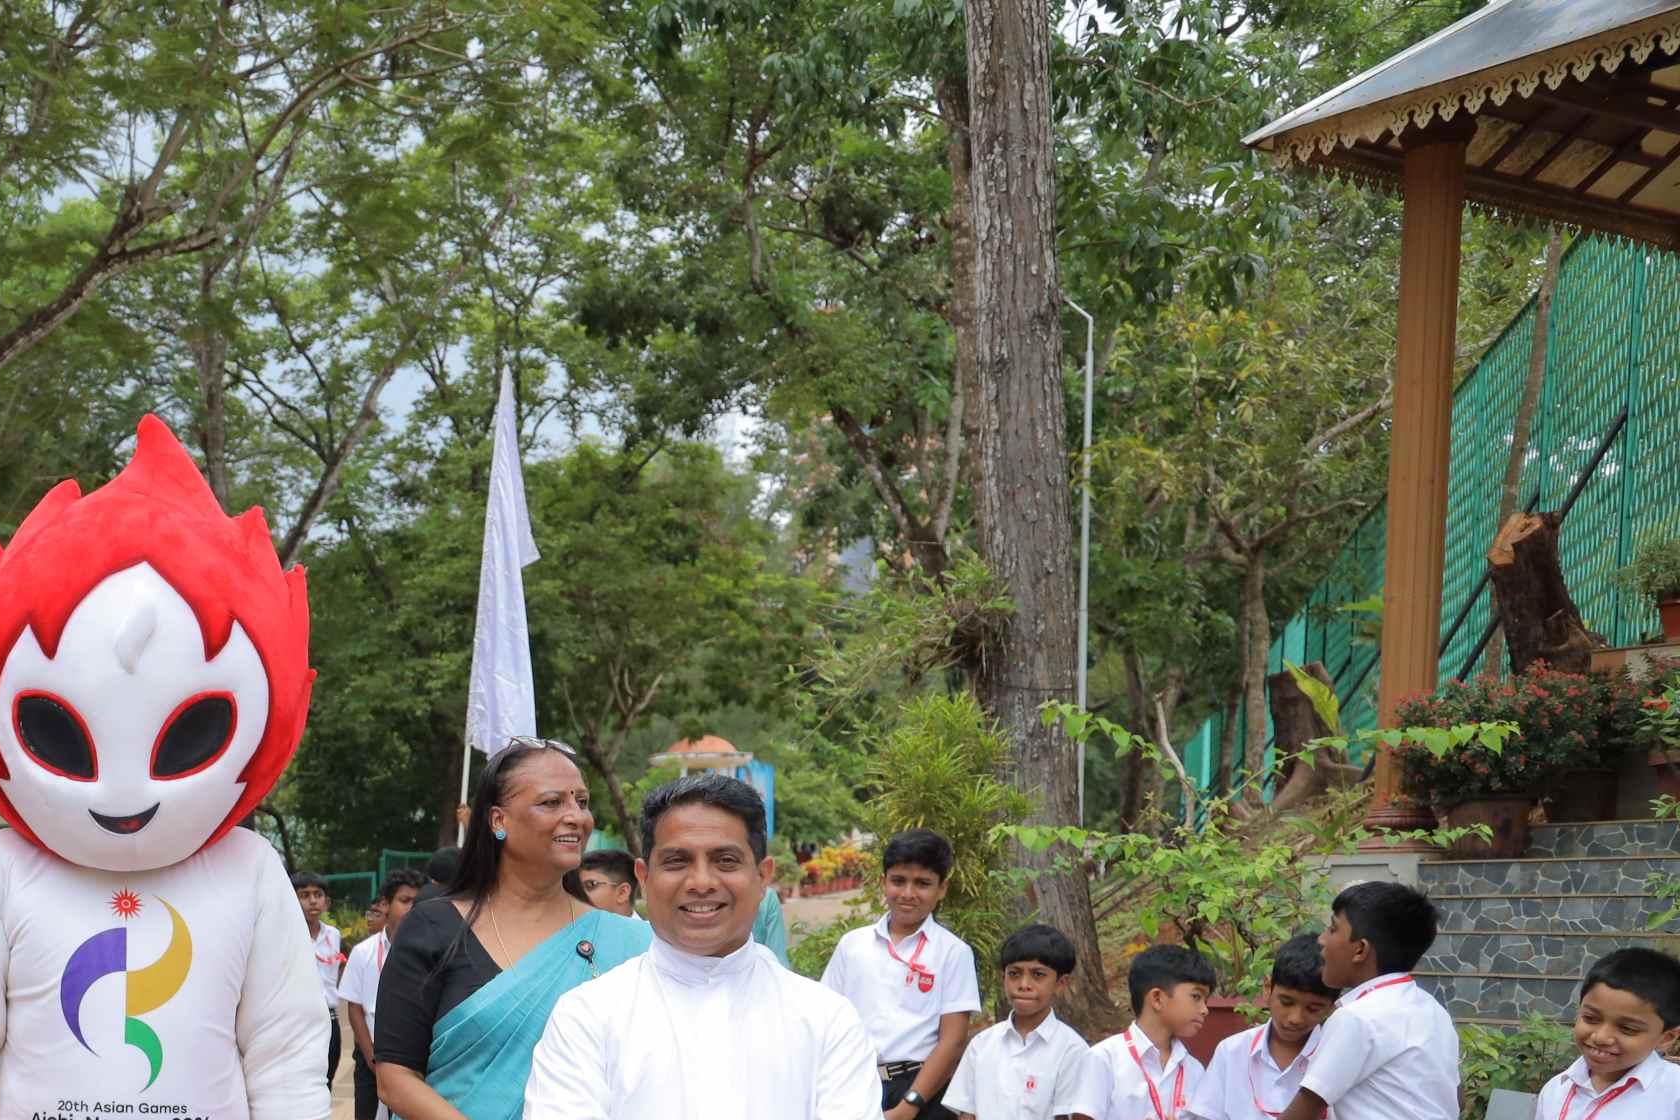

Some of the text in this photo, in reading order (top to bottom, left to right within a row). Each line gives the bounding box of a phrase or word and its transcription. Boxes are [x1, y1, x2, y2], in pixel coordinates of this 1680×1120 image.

[57, 1100, 188, 1114] 20th Asian Games
